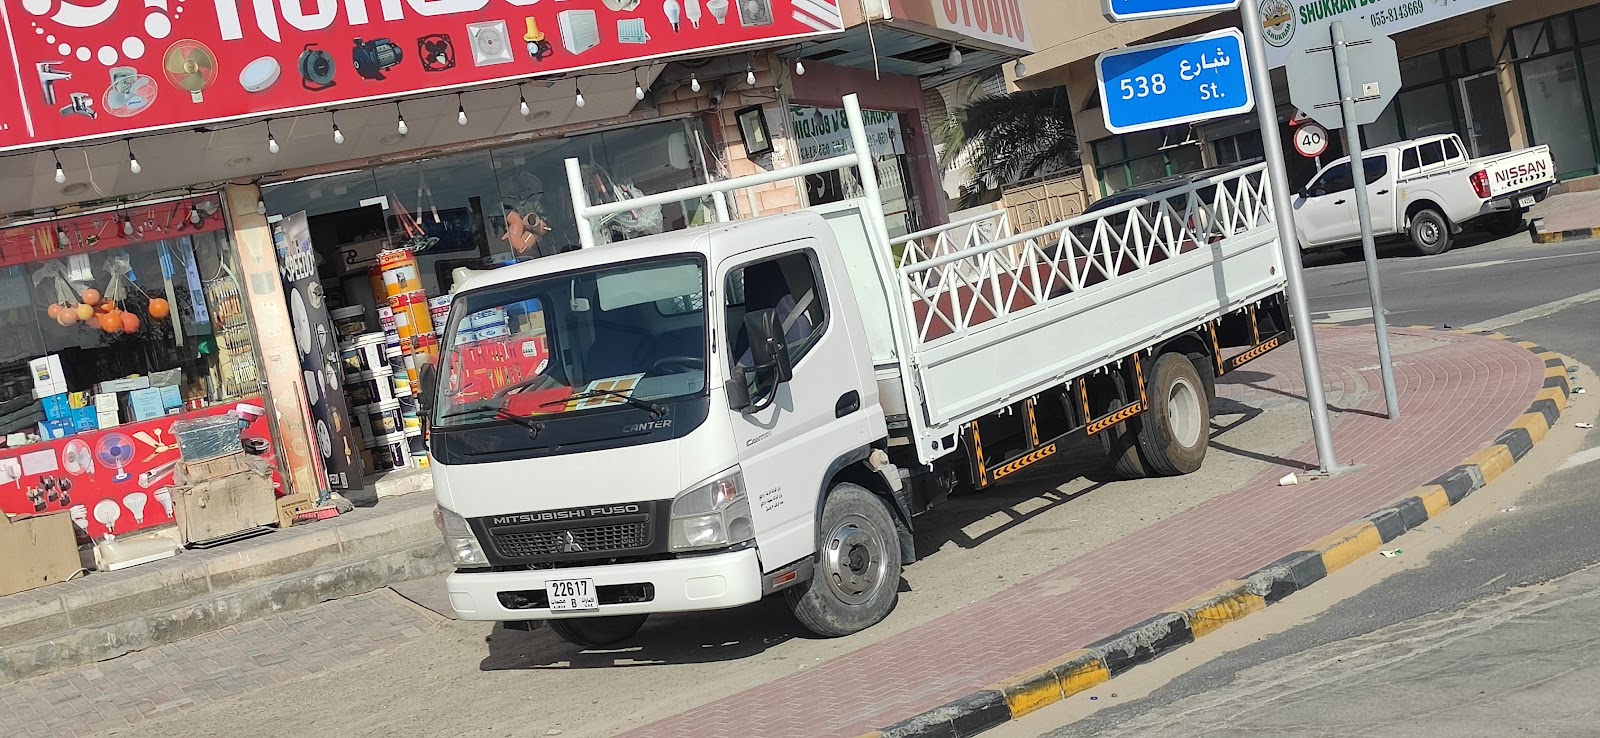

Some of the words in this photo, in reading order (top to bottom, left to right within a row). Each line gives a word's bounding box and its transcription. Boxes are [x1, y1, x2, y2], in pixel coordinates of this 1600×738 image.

[1370, 4, 1424, 27] 055-8143669
[1179, 47, 1231, 81] شارع
[1120, 73, 1167, 100] 538
[1200, 82, 1225, 100] St.
[1302, 132, 1321, 146] 40
[1495, 159, 1546, 183] NISSAN
[285, 249, 315, 282] SPEEDO
[622, 419, 672, 433] CANTER
[493, 509, 585, 525] MITSUBISHI
[590, 504, 640, 516] FUSO
[552, 580, 587, 597] 22617
[571, 598, 577, 608] B
